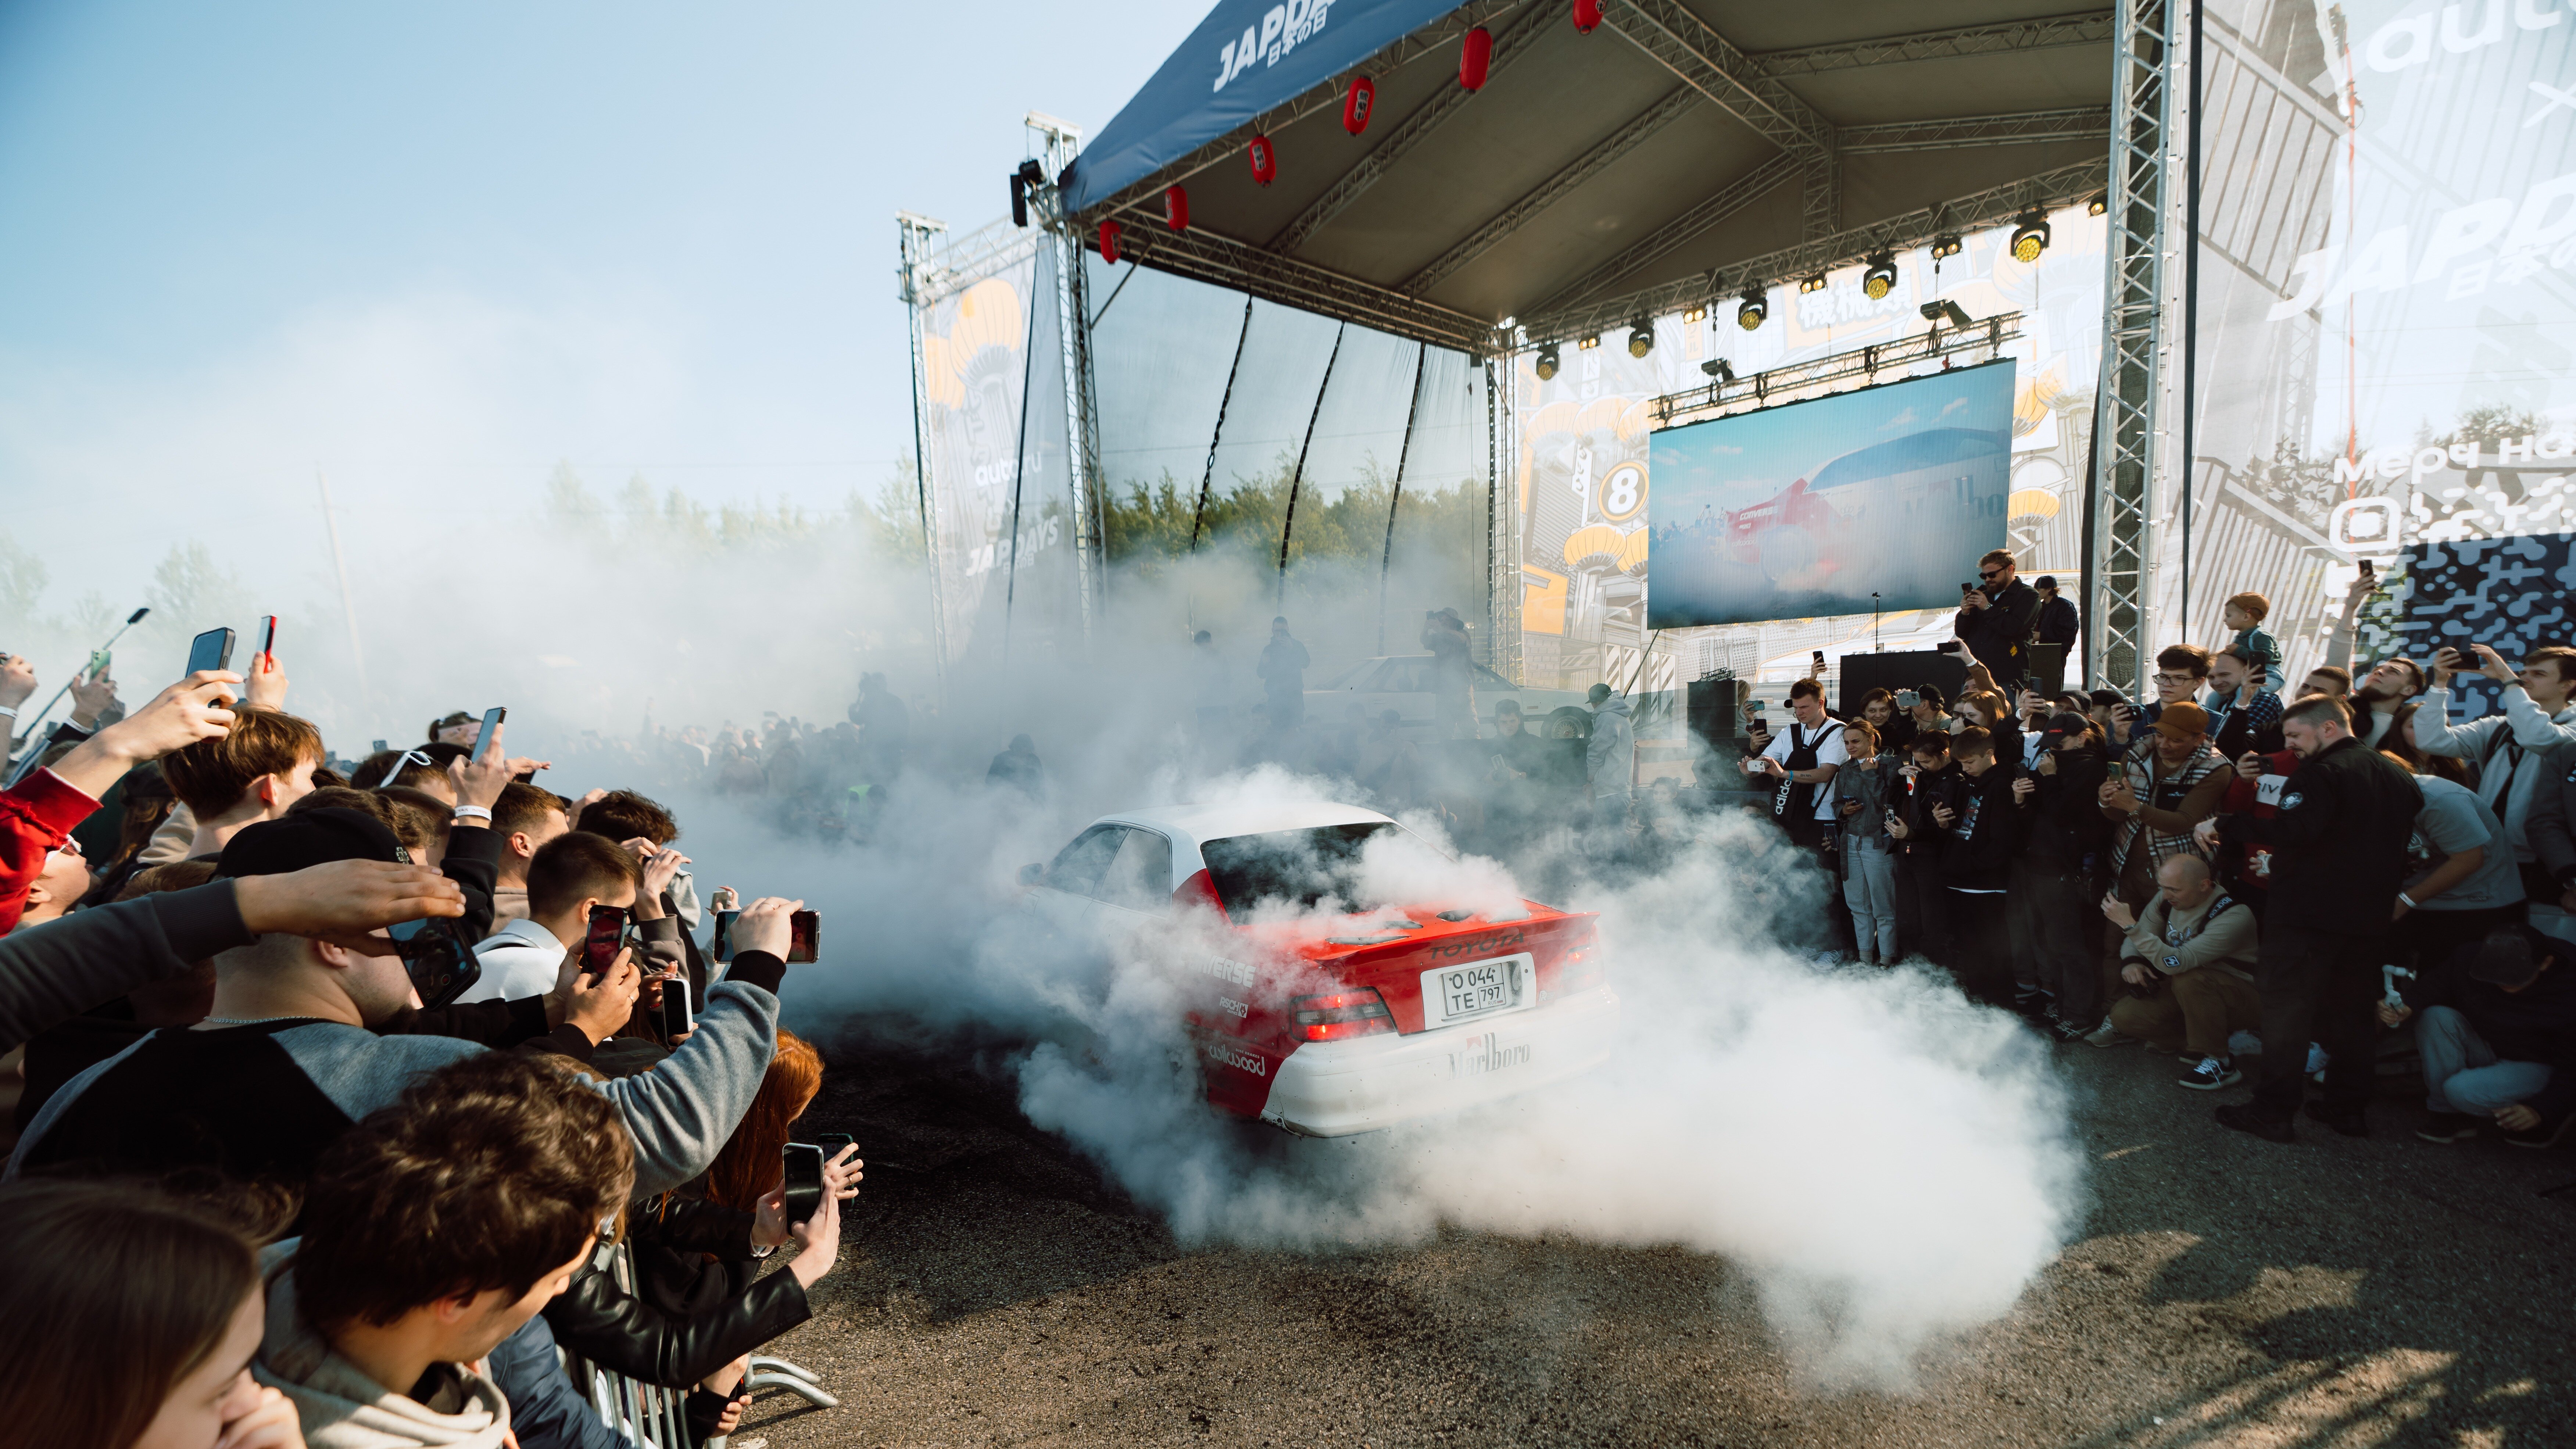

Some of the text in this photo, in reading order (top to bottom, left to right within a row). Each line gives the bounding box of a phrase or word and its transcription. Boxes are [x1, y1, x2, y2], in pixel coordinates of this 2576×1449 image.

[1267, 4, 1328, 69] 日本の日
[1607, 467, 1639, 514] 8
[965, 515, 1058, 577] JAPDAYS
[1775, 779, 1792, 815] adida
[1430, 933, 1524, 959] TOYOTA
[1468, 967, 1495, 987] 044
[1480, 987, 1500, 1002] 797
[1209, 1044, 1265, 1076] wilwood
[1447, 1032, 1530, 1081] Marlboro
